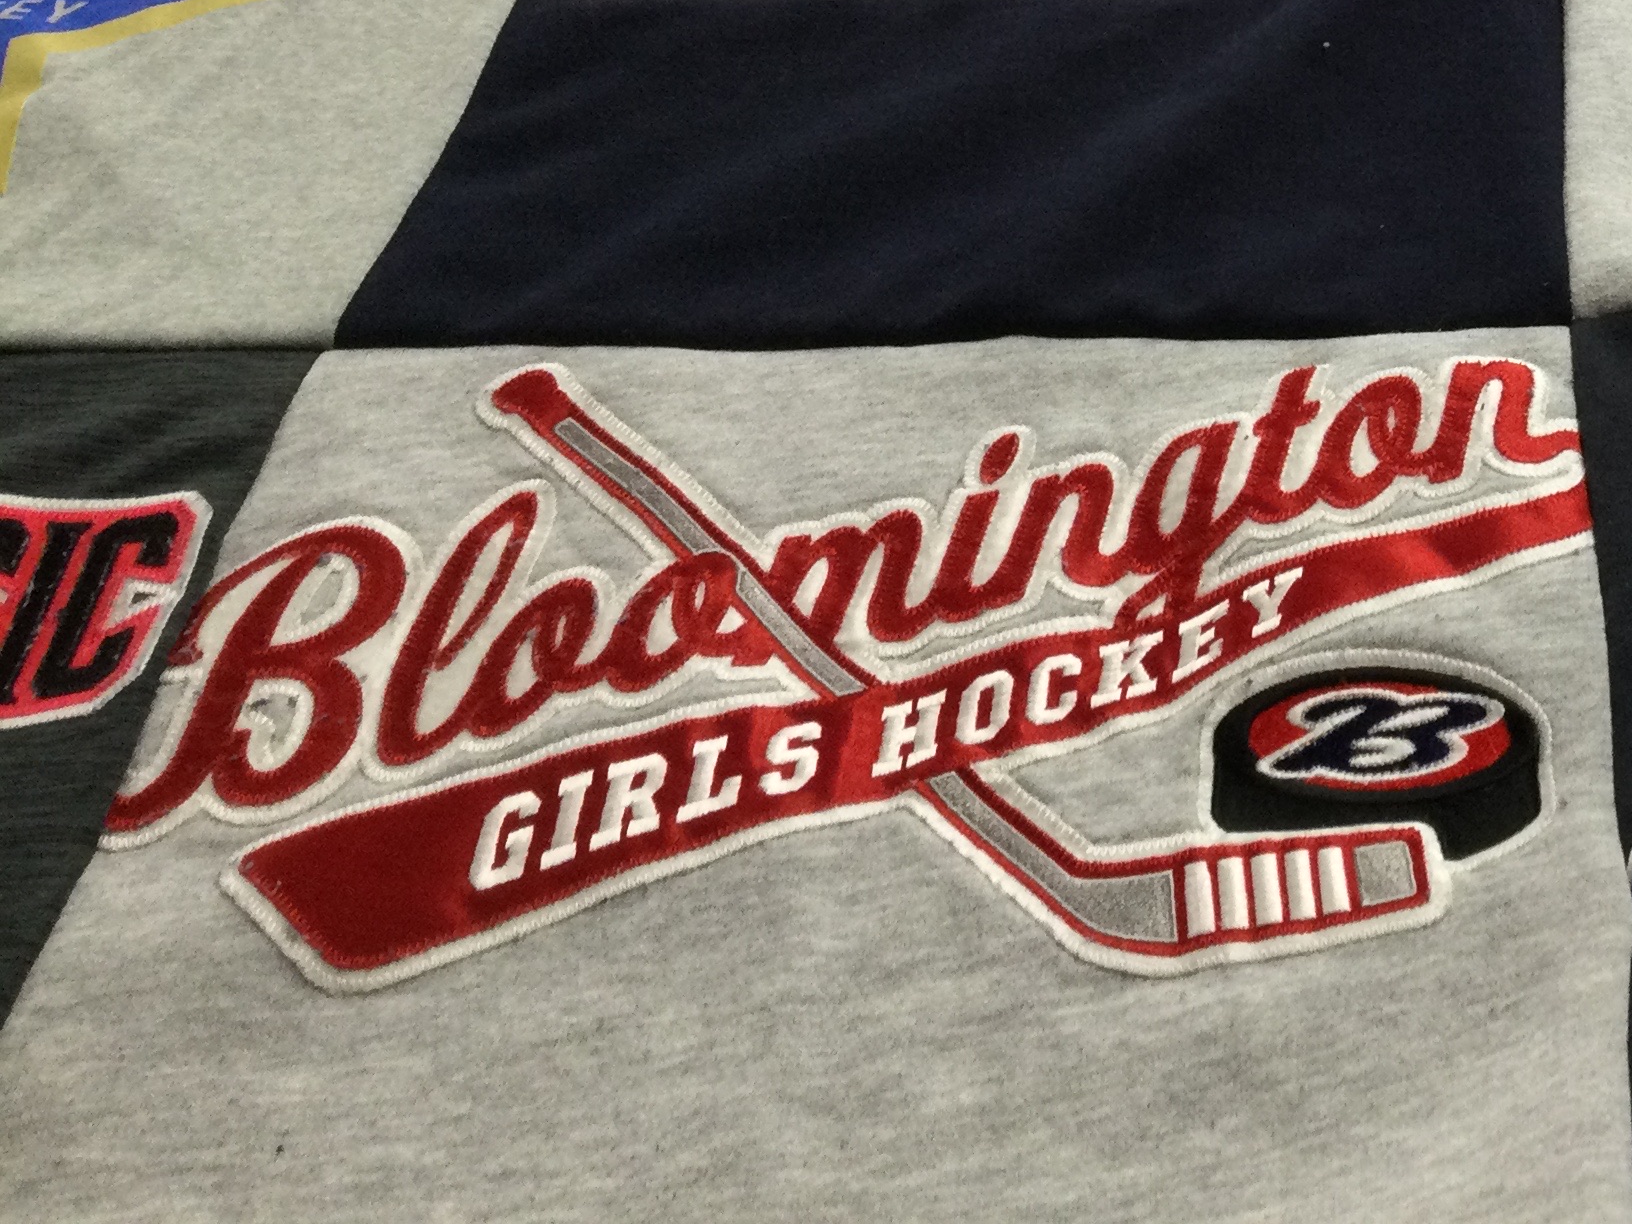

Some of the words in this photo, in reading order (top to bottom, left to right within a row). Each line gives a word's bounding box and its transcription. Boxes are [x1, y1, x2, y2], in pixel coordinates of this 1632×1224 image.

[102, 360, 1581, 836] Bloomington
[469, 722, 823, 892] GIRLS
[870, 567, 1305, 779] HOCKEY
